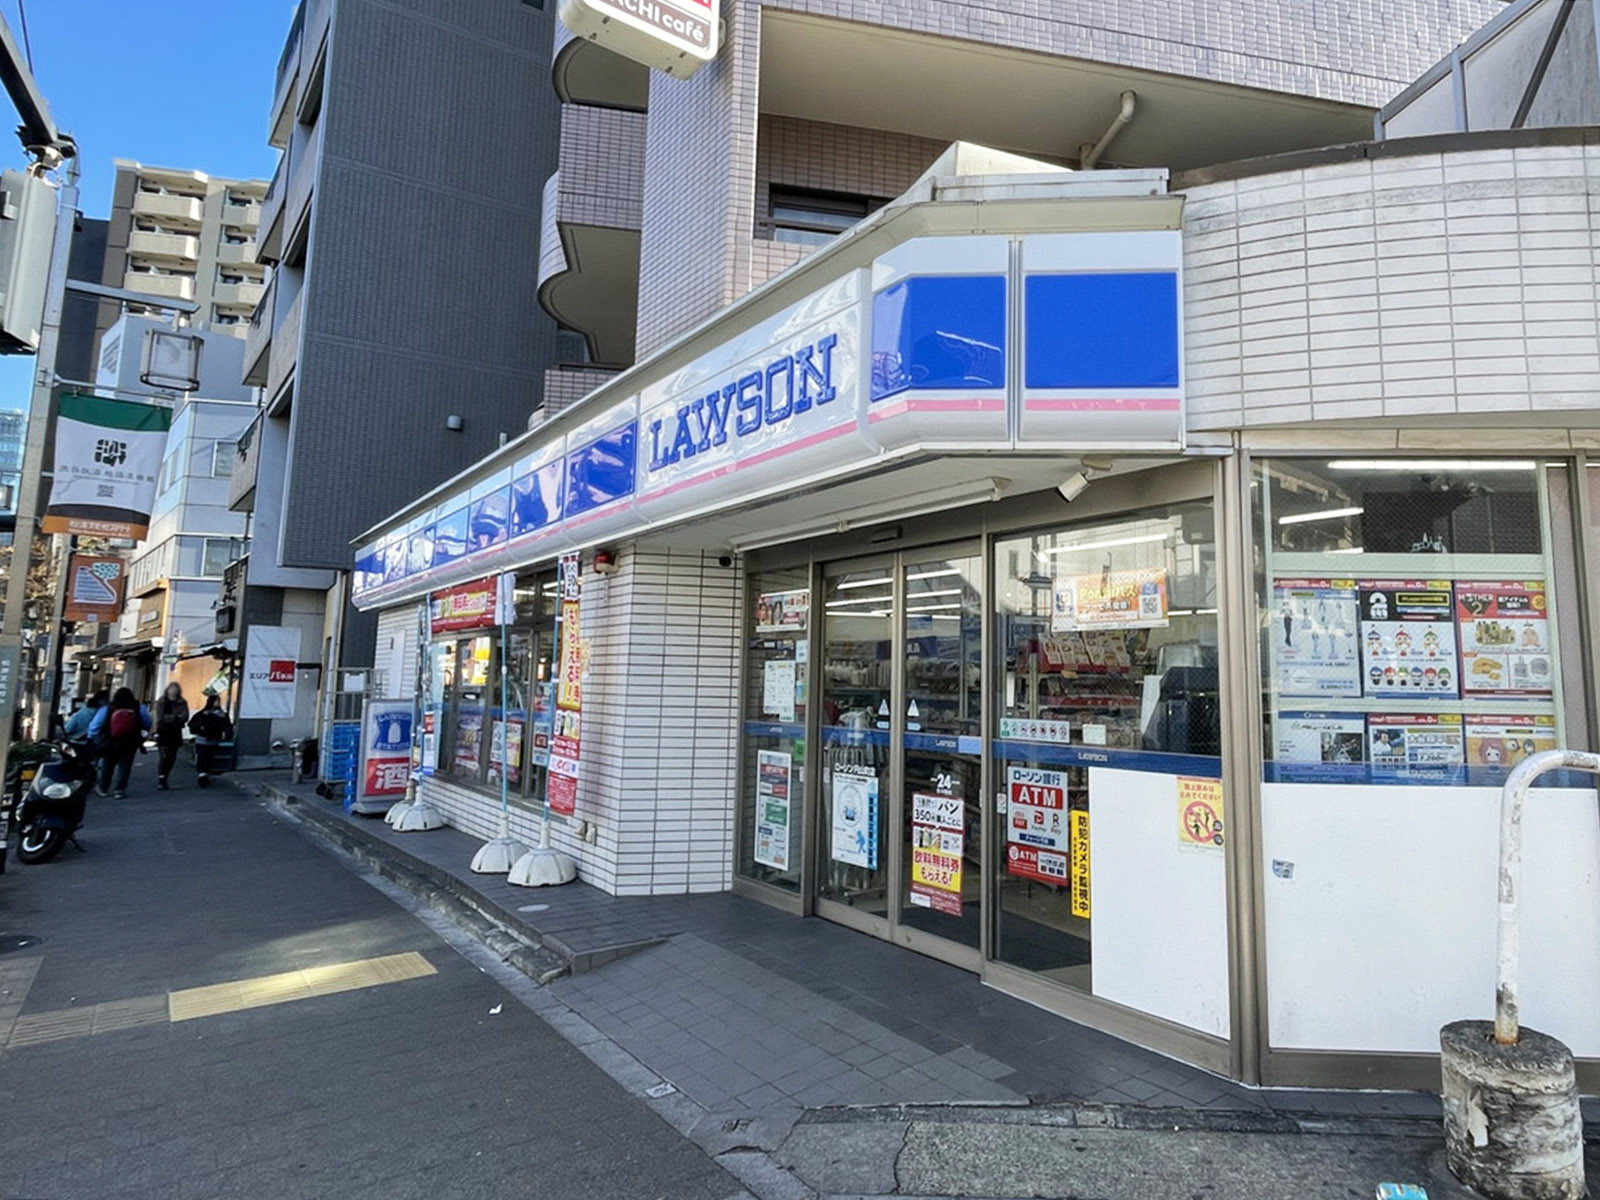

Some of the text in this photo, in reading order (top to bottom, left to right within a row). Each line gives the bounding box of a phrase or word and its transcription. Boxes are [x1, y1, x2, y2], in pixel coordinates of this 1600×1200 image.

[661, 11, 705, 42] café
[649, 333, 837, 472] LAWSON
[374, 762, 410, 791] 酒
[1013, 770, 1061, 786] ローソン銀行
[938, 800, 959, 815] パン
[1018, 785, 1057, 808] ATM
[914, 850, 960, 873] 飲料無料券
[1019, 850, 1037, 862] ATM
[1078, 815, 1089, 912] 防犯カメラ監視中
